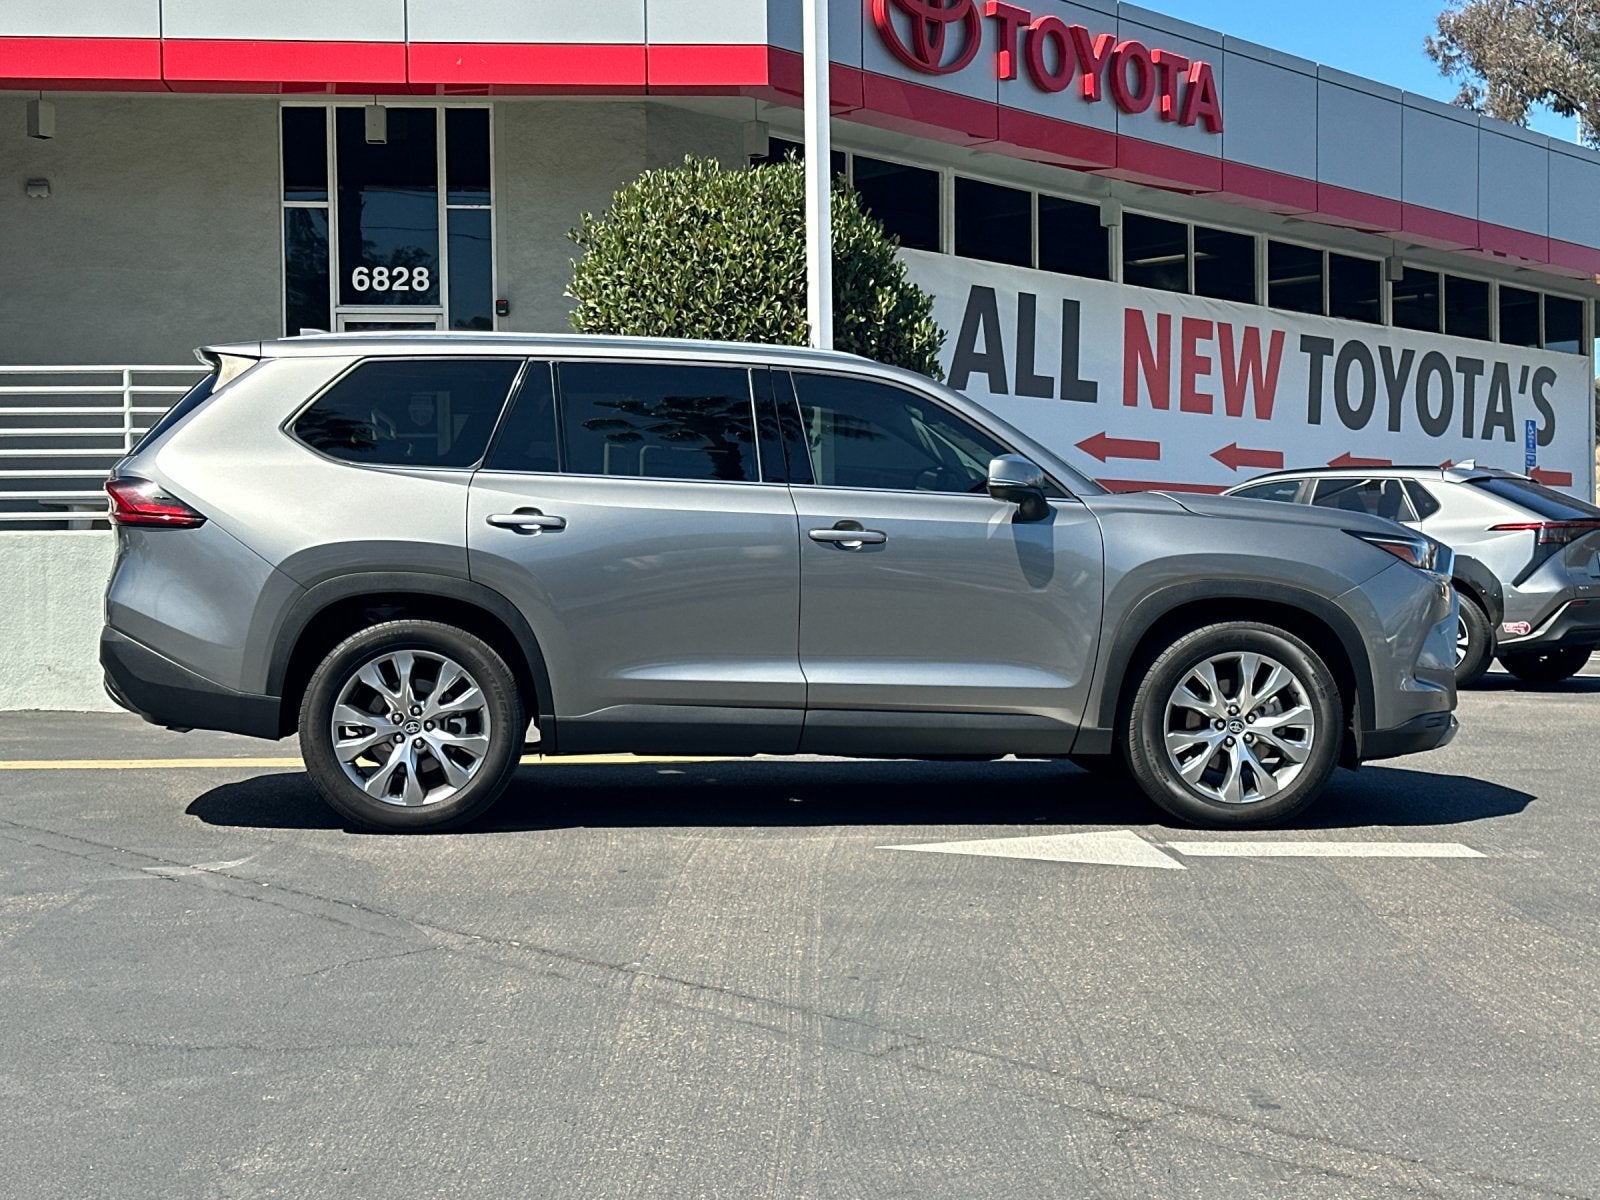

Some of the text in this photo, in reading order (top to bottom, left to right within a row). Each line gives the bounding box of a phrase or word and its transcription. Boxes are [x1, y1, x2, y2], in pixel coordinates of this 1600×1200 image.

[986, 0, 1223, 134] TOYOTA
[352, 266, 430, 292] 6828
[947, 284, 1557, 447] ALL NEW TOYOTA'S
